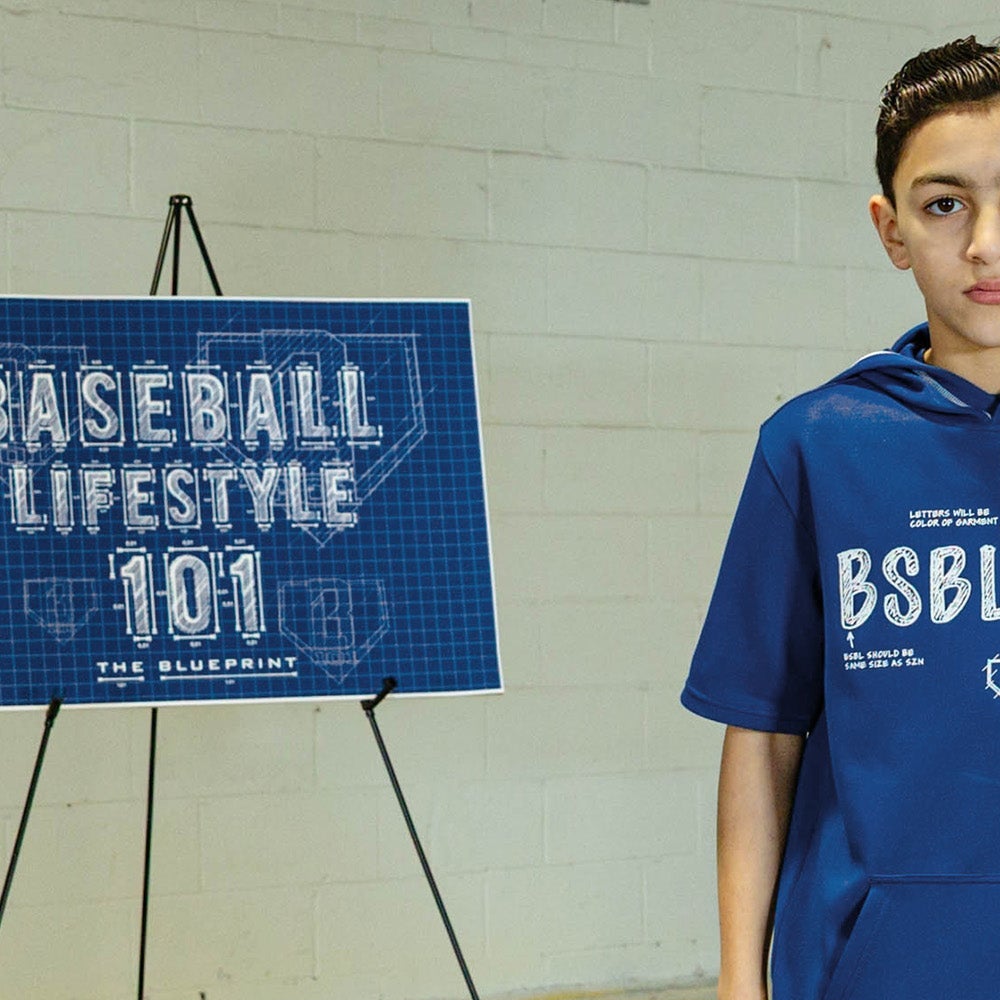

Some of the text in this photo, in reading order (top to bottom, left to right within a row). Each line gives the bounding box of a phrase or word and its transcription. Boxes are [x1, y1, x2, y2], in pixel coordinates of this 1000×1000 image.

[0, 370, 378, 442] ASEBALL
[14, 465, 353, 526] LIFESTYLE
[909, 508, 990, 519] LETTERS WILL BE
[909, 517, 998, 528] COLOR OF GARMENT
[121, 554, 259, 634] 101
[866, 649, 900, 659] SHOULD
[96, 657, 298, 674] THE BLUEPRINT
[868, 659, 889, 668] SIZE
[891, 658, 903, 667] AS
[905, 658, 925, 666] SZN
